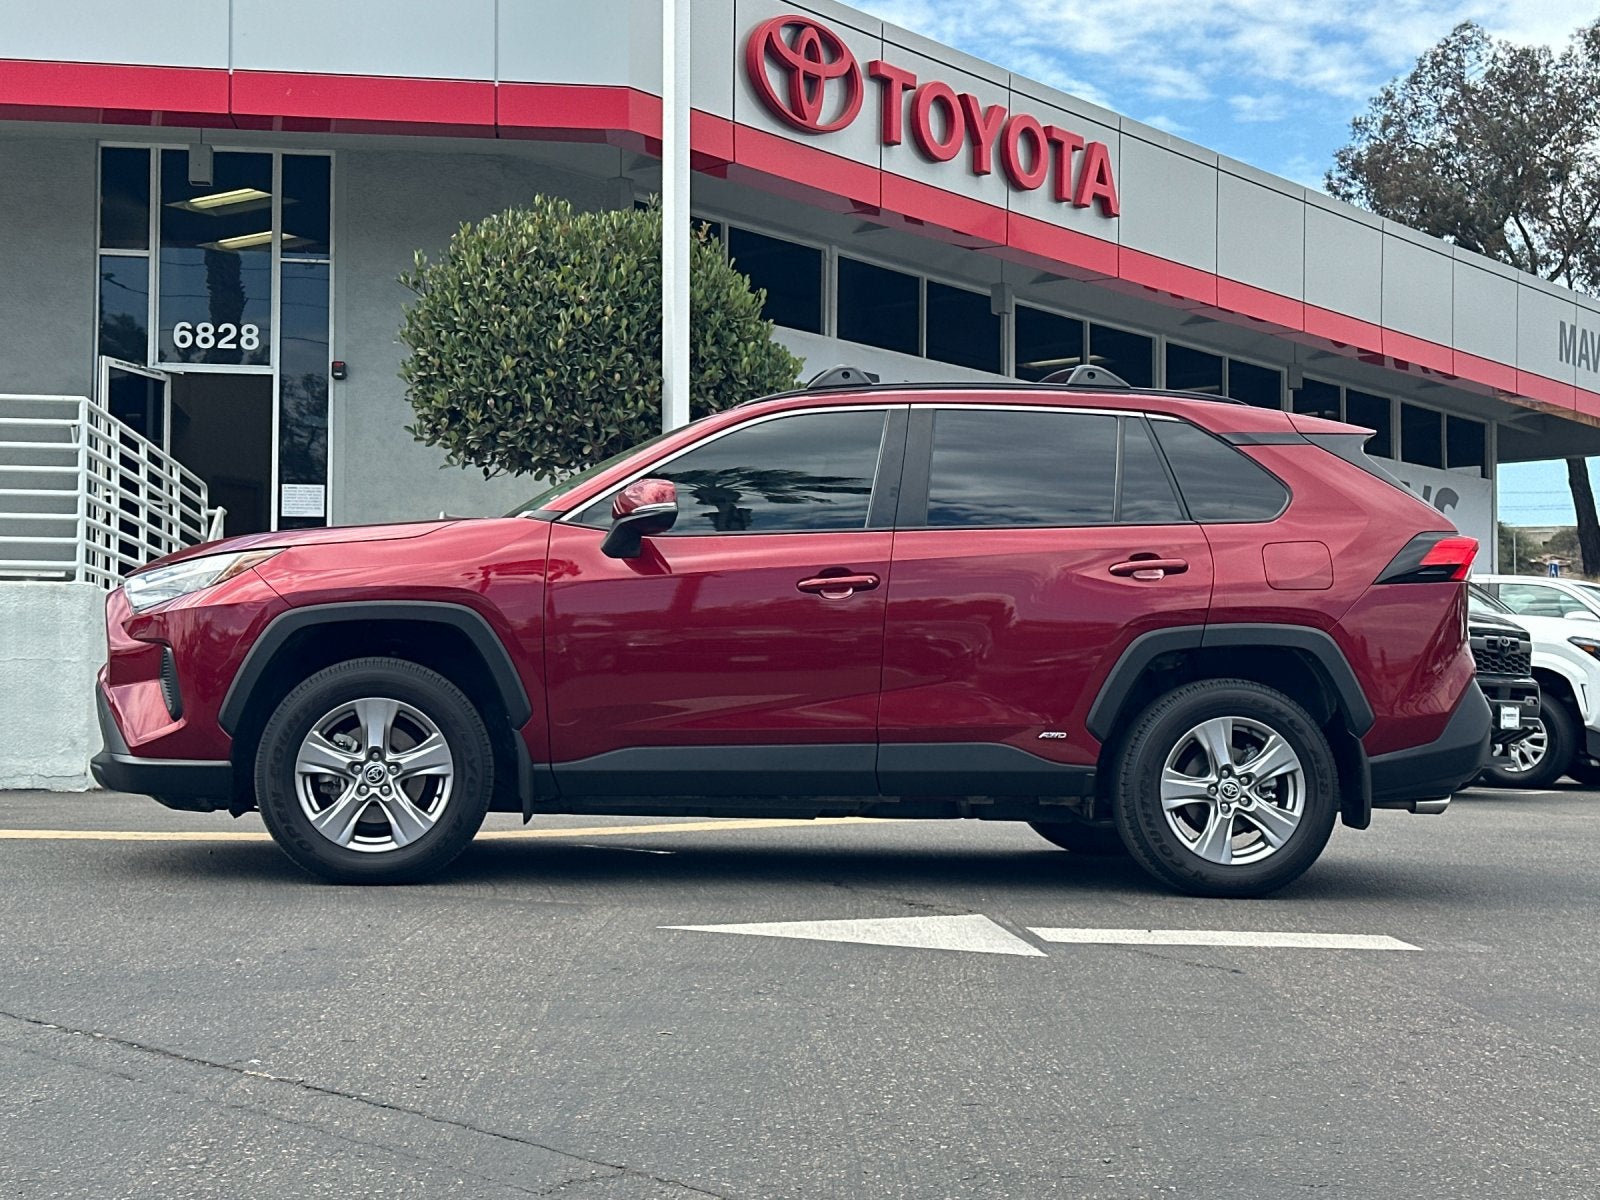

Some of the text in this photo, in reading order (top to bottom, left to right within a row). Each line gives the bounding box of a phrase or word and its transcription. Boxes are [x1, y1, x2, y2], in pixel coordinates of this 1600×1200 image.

[868, 59, 1121, 218] TOYOTA
[173, 321, 260, 351] 6828
[1038, 731, 1067, 739] AWD
